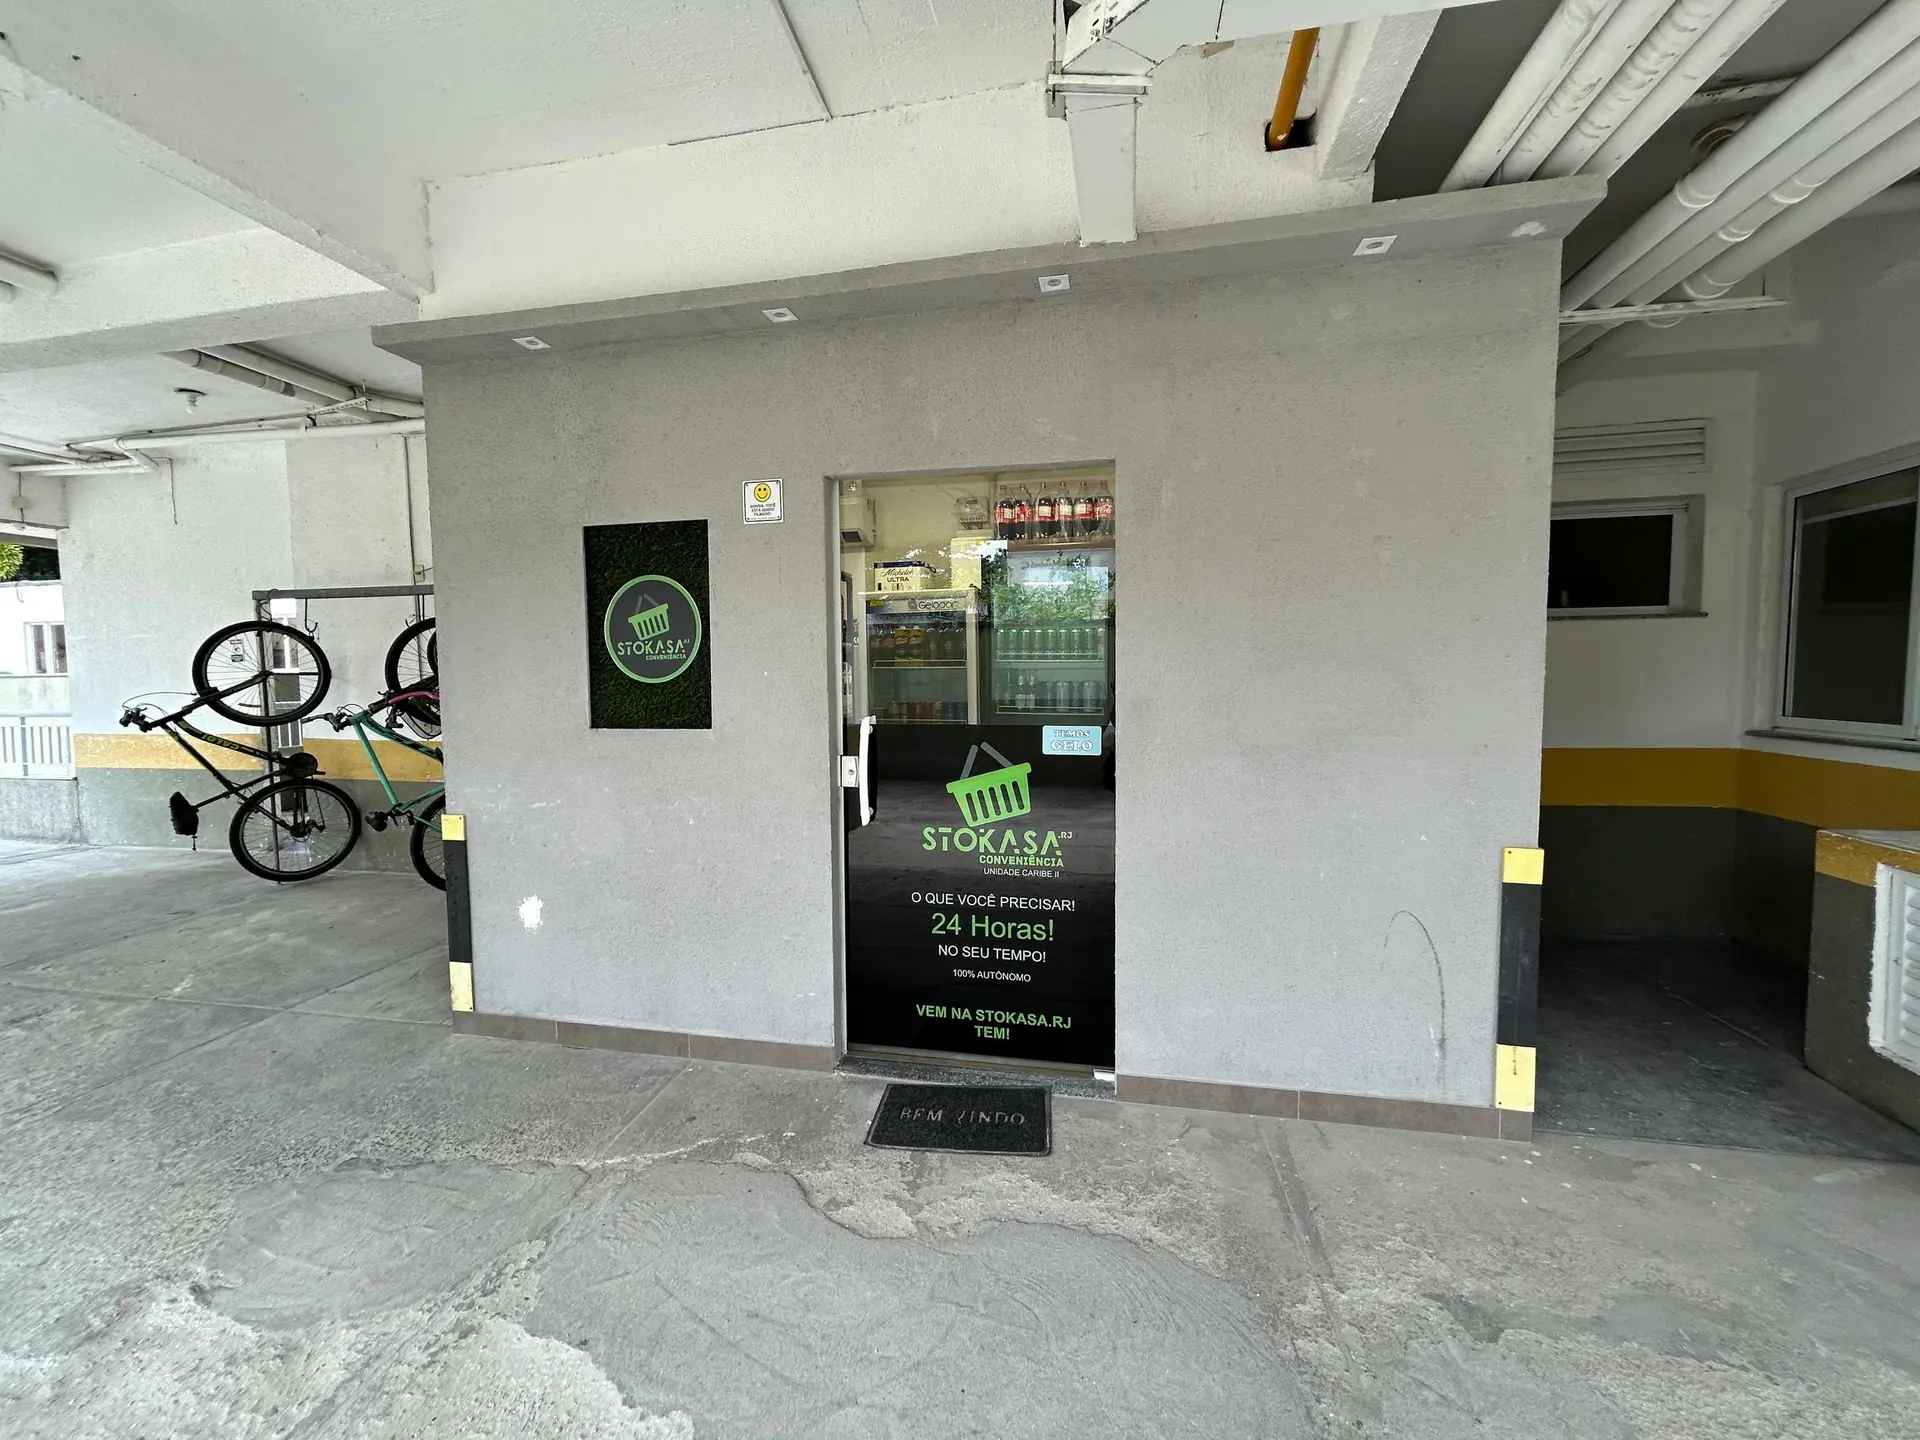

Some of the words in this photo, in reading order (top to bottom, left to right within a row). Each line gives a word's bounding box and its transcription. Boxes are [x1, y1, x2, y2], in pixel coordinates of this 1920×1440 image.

[617, 639, 686, 656] STOKASA
[1054, 729, 1090, 738] TEMOS
[1051, 739, 1093, 751] GELO
[922, 826, 1063, 856] STOKASA
[979, 854, 1064, 867] CONVENIÊNCIA
[984, 868, 1020, 876] UNIDADE
[1022, 869, 1052, 878] CARIBE
[911, 892, 922, 904] O
[925, 892, 954, 905] QUE
[957, 893, 996, 907] VOCÊ
[1000, 897, 1075, 912] PRECISAR!
[931, 912, 962, 936] 24
[971, 914, 1054, 942] Horas!
[938, 944, 958, 957] NO
[962, 946, 990, 959] SEU
[993, 948, 1046, 963] TEMPO!
[952, 968, 976, 979] 100%
[977, 970, 1031, 982] AUTÔNOMO
[916, 1004, 947, 1018] VEM
[951, 1007, 972, 1020] NA
[975, 1010, 1071, 1028] STOKASA.RJ
[974, 1025, 1010, 1040] TEM!
